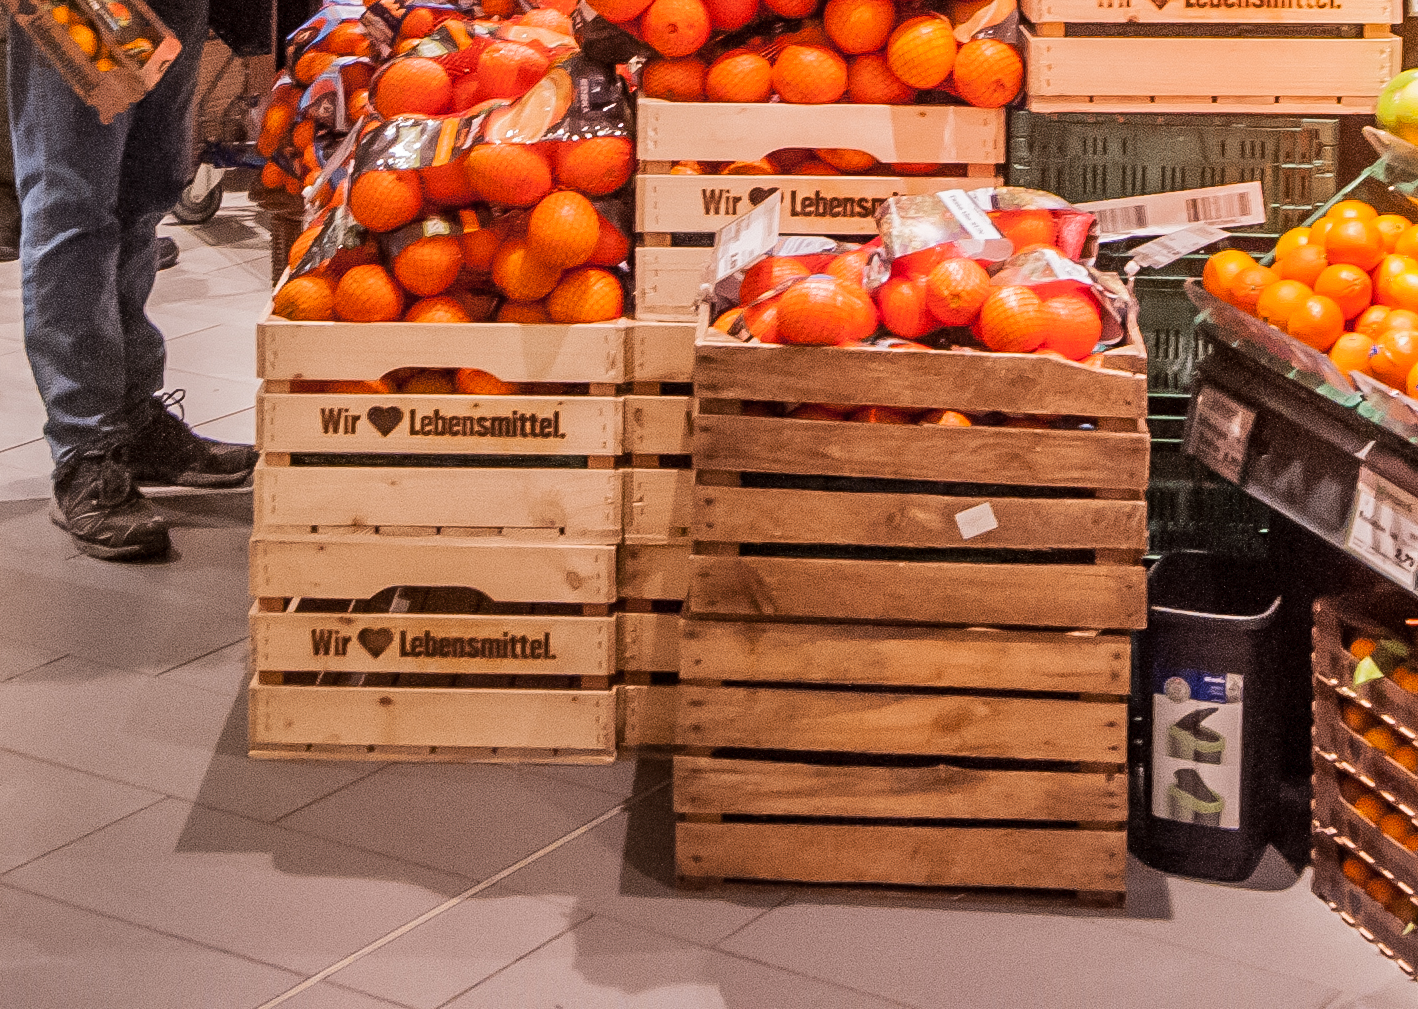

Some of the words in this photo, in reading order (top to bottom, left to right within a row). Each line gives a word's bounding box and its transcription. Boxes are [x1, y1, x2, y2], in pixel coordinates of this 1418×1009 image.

[702, 189, 743, 216] Wir
[320, 407, 361, 435] Wir
[408, 409, 567, 439] Lebensmittel.
[311, 628, 352, 657] Wir
[399, 630, 557, 659] Lebensmittel.
